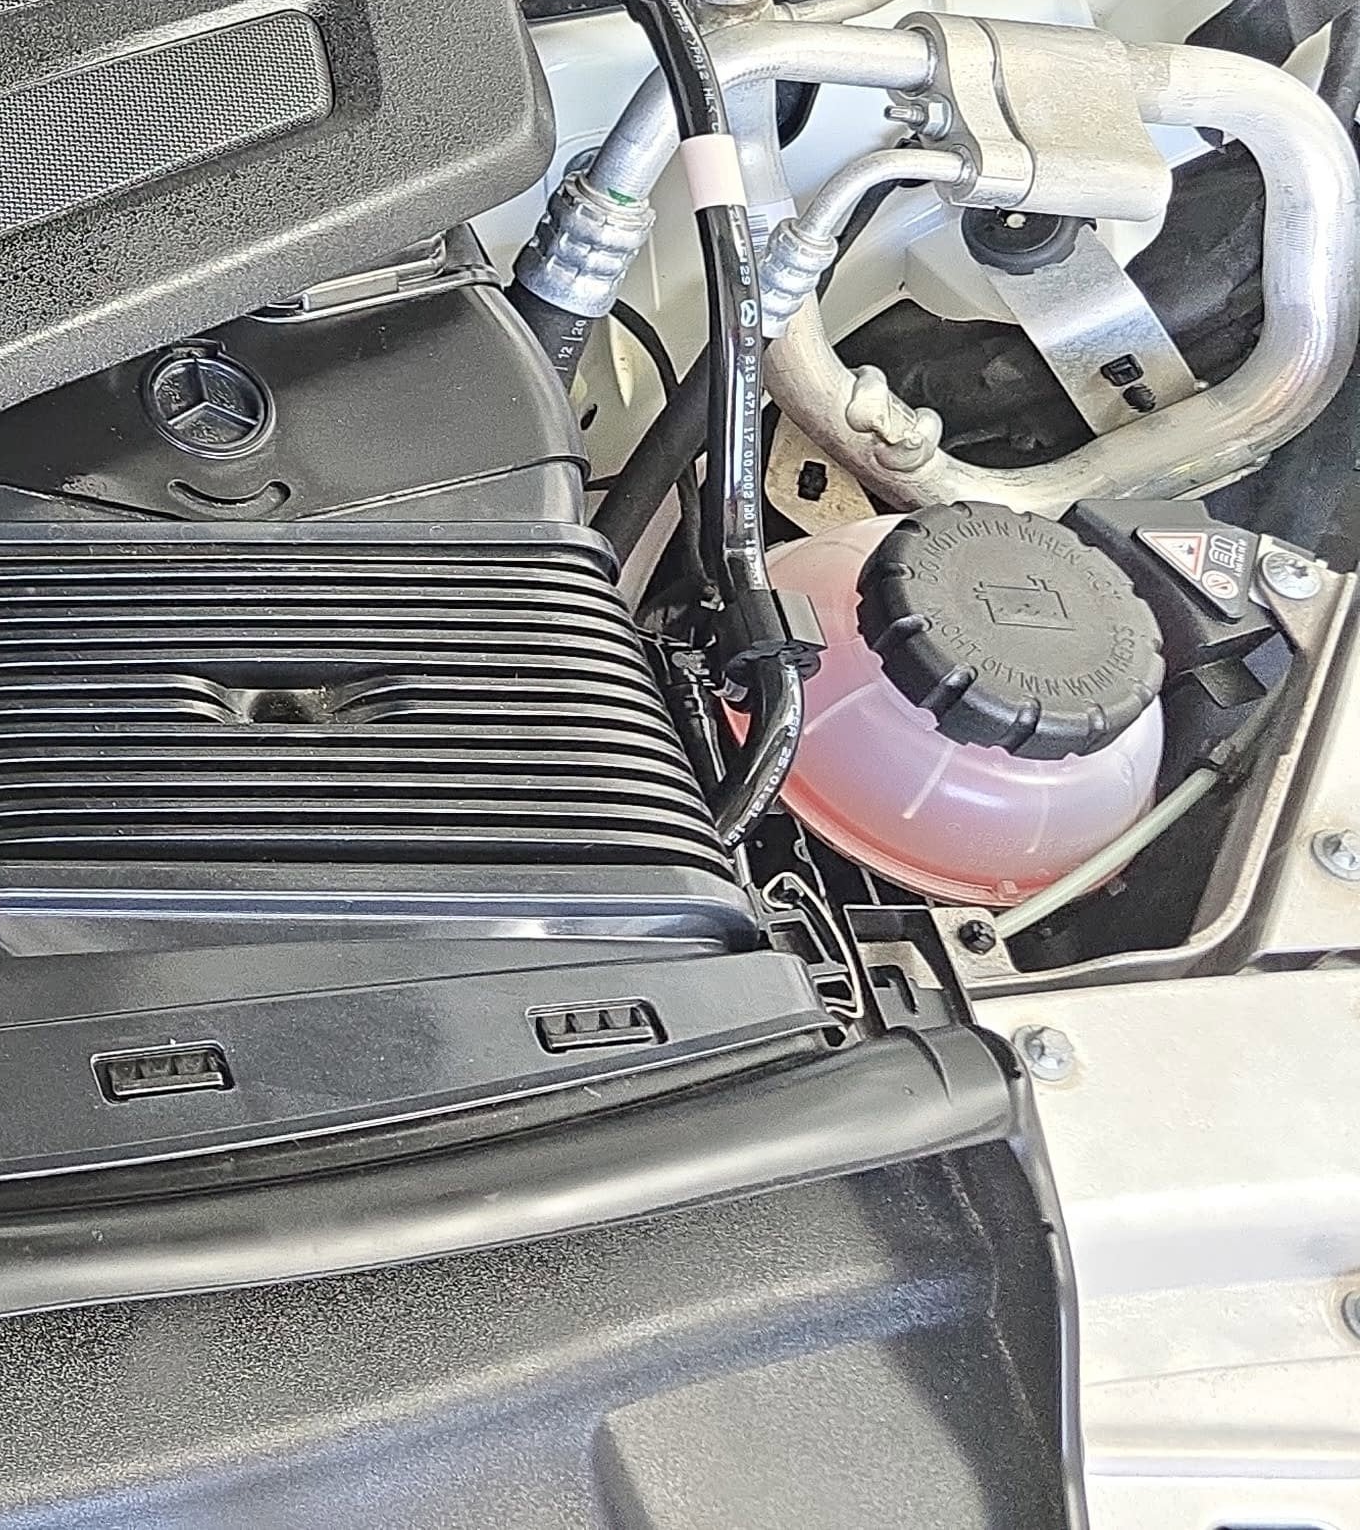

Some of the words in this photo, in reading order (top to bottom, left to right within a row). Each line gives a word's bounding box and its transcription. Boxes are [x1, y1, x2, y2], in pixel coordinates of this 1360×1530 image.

[744, 355, 756, 383] 213
[744, 391, 756, 416] 471
[957, 518, 1010, 539] OPEN
